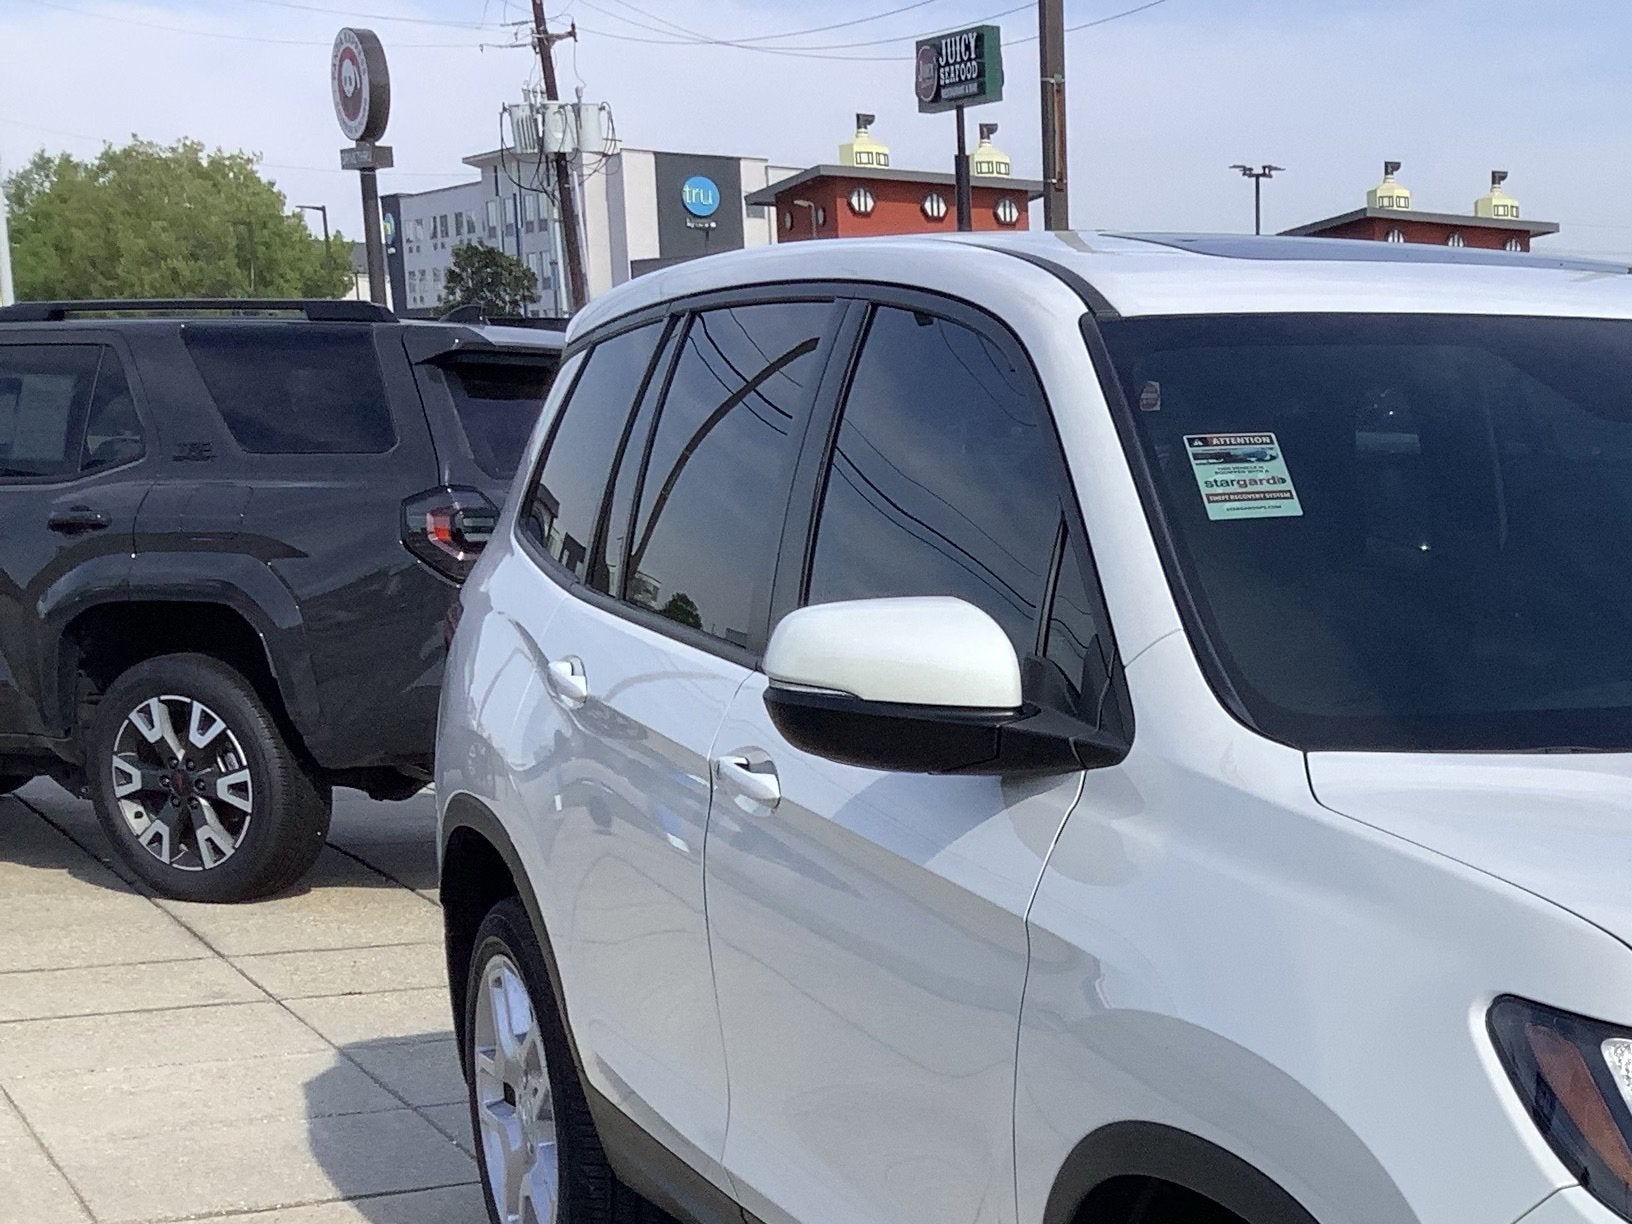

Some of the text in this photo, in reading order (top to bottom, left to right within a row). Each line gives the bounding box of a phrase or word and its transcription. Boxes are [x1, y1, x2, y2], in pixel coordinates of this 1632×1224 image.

[939, 32, 978, 67] JUICY
[940, 60, 979, 86] SEAFOOD
[682, 184, 713, 205] tru
[1212, 437, 1271, 445] ATTENTION
